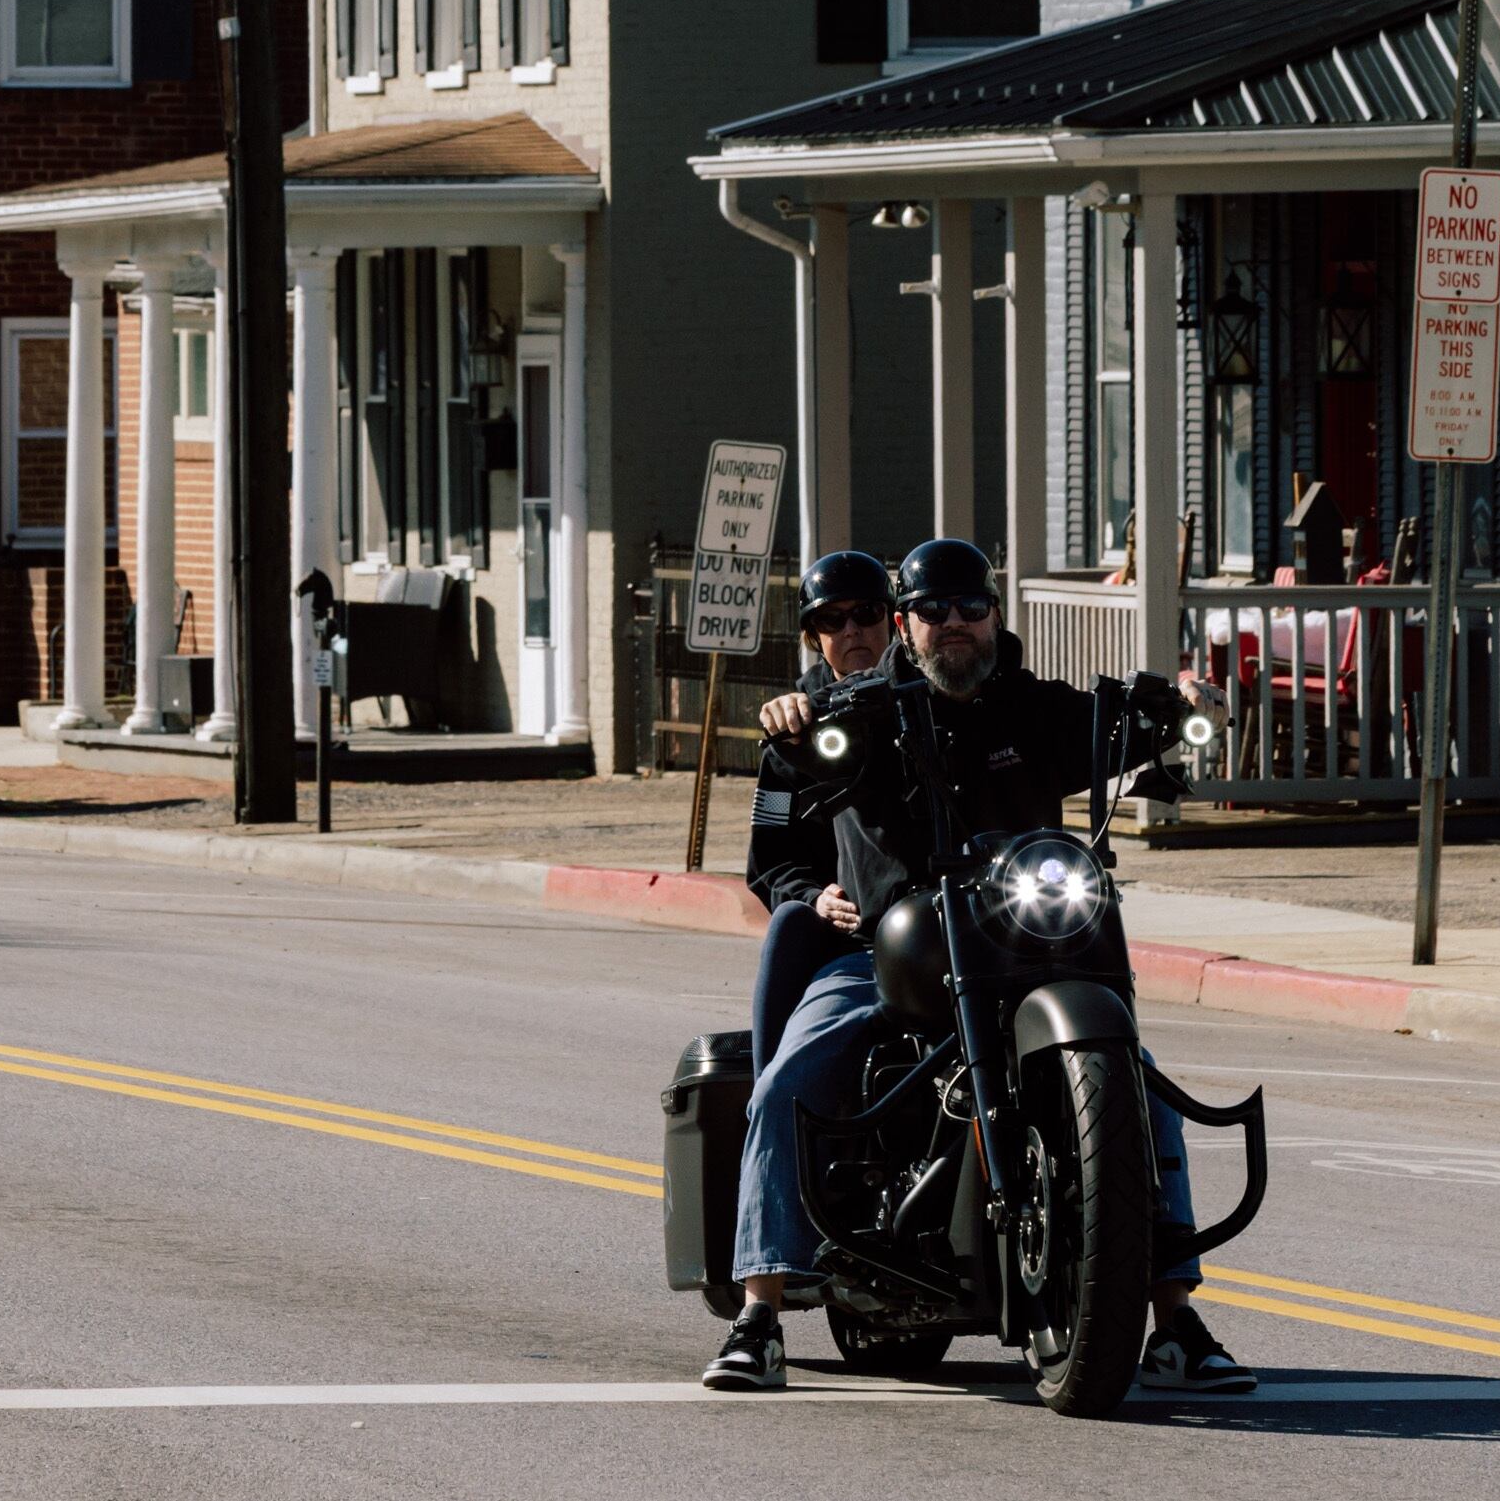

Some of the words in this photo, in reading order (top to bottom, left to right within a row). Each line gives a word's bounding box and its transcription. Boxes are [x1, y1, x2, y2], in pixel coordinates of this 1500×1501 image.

[1449, 185, 1478, 209] NO
[1426, 216, 1497, 242] PARKING
[1426, 247, 1494, 267] BETWEEN
[1438, 271, 1481, 289] SIGNS
[1447, 304, 1469, 316] NO
[1425, 318, 1488, 337] PARKING
[1440, 340, 1473, 358] THIS
[1439, 361, 1473, 378] SIDE
[1435, 422, 1469, 432] FRIDAY
[1439, 436, 1464, 446] ONLY
[713, 459, 778, 481] AUTHORIZED
[716, 489, 764, 510] PARKING
[722, 520, 750, 539] ONLY
[699, 554, 723, 572] DO
[730, 557, 761, 575] NOT
[698, 583, 757, 607] BLOCK
[698, 616, 751, 639] DRIVE
